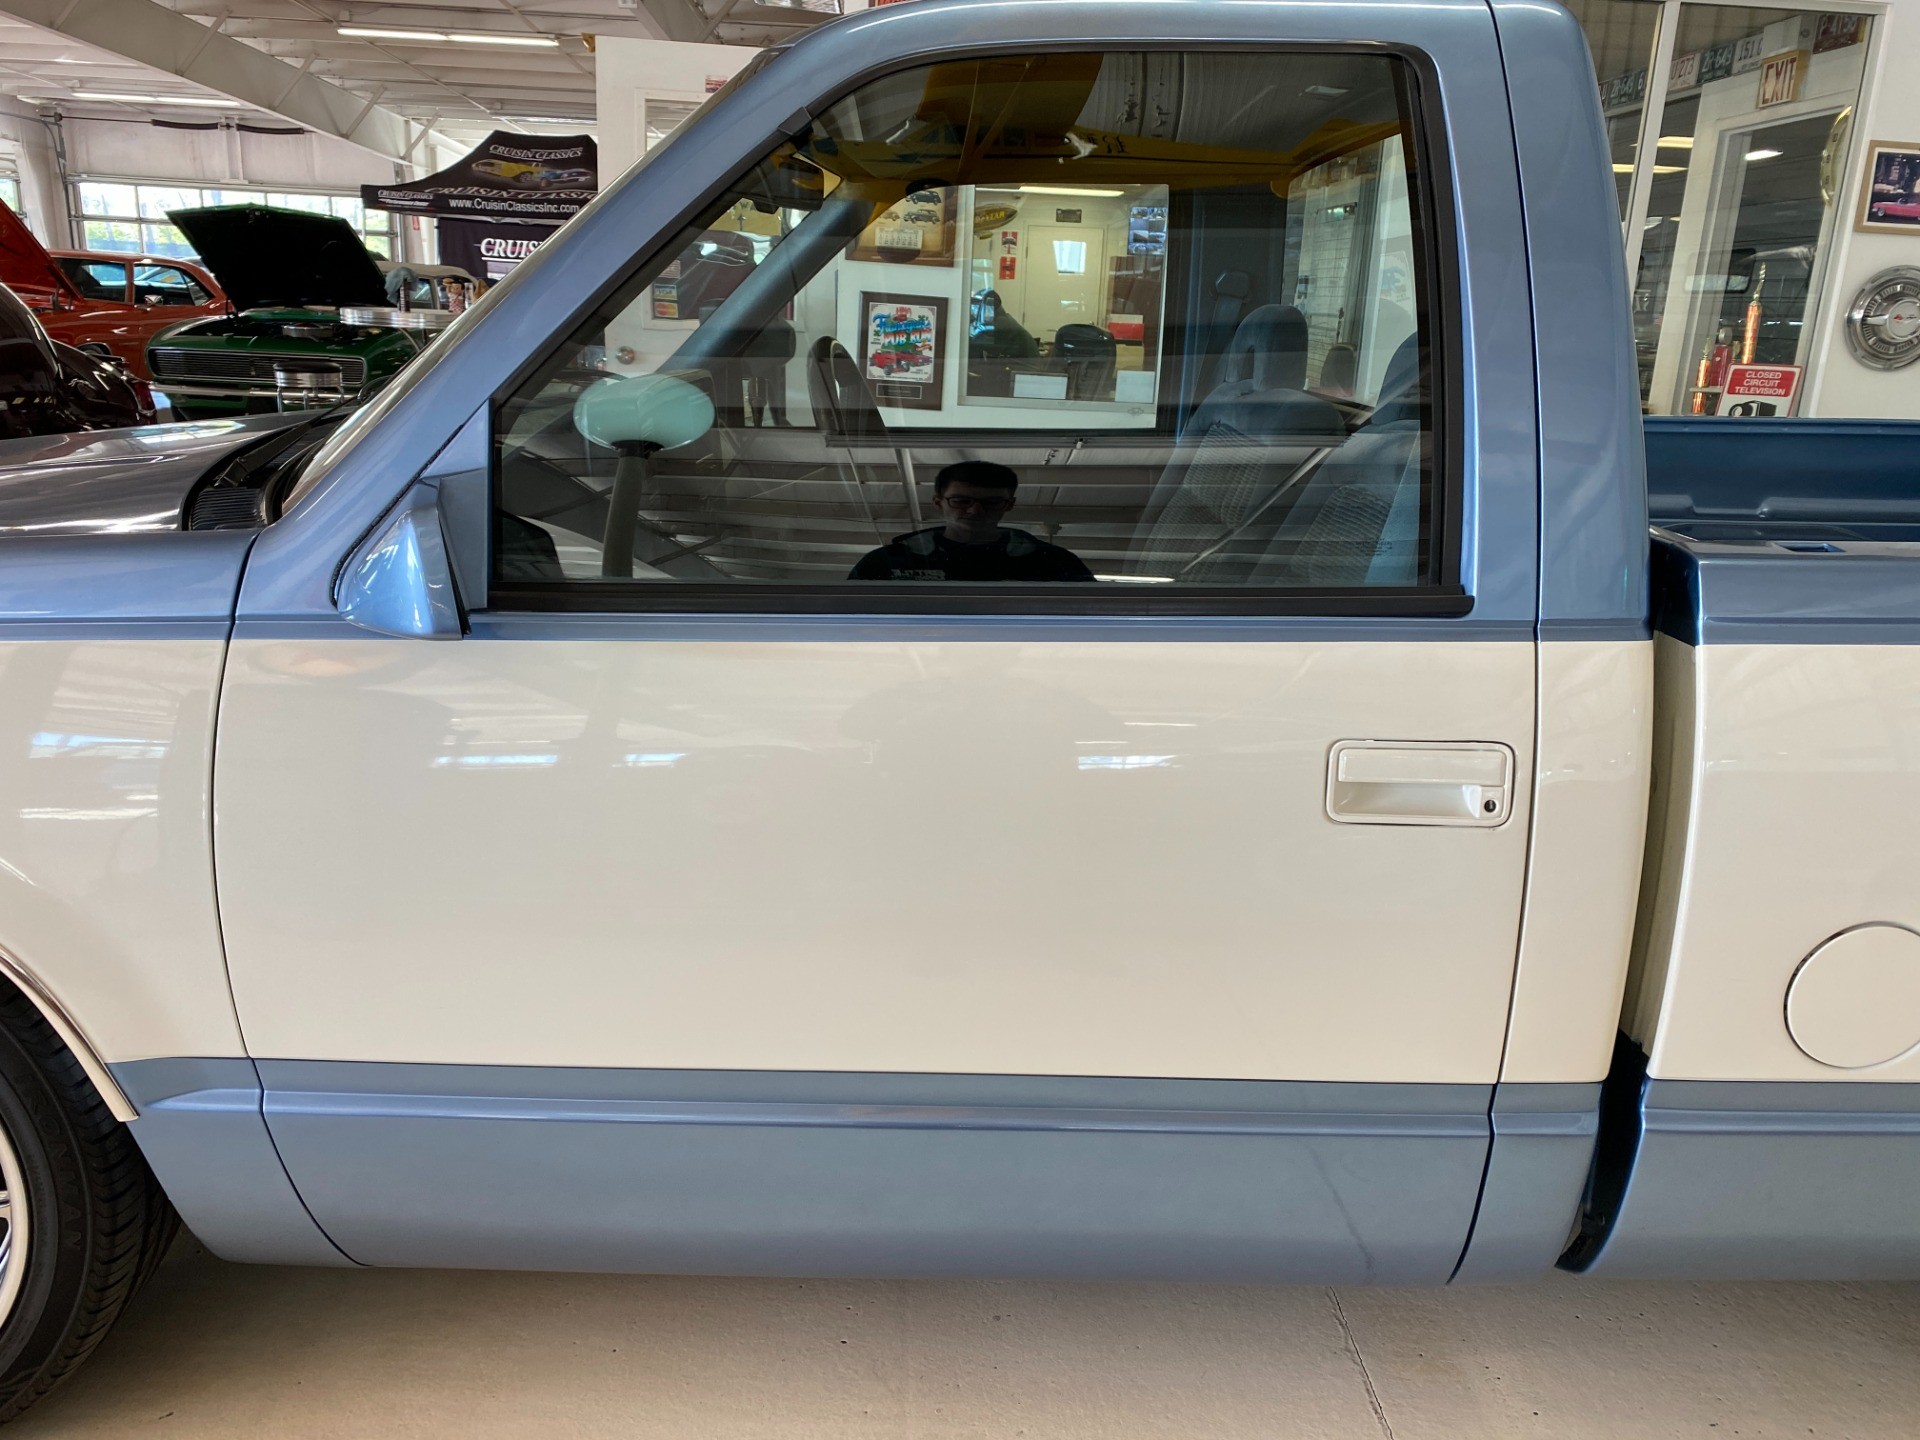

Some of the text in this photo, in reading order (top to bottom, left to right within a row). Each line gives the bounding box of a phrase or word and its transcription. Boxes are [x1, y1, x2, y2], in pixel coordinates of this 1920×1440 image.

[1762, 56, 1797, 104] EXIT
[489, 144, 583, 160] CRUISIN CLASSICS
[424, 187, 513, 198] CRUISIN
[448, 198, 580, 214] www.CruisinClassicsInc.com
[480, 238, 543, 258] CRUIS
[883, 331, 907, 347] PUB
[1743, 378, 1781, 387] CIRCUIT
[1745, 370, 1782, 379] CLOSED
[1734, 386, 1786, 396] TELEVISION
